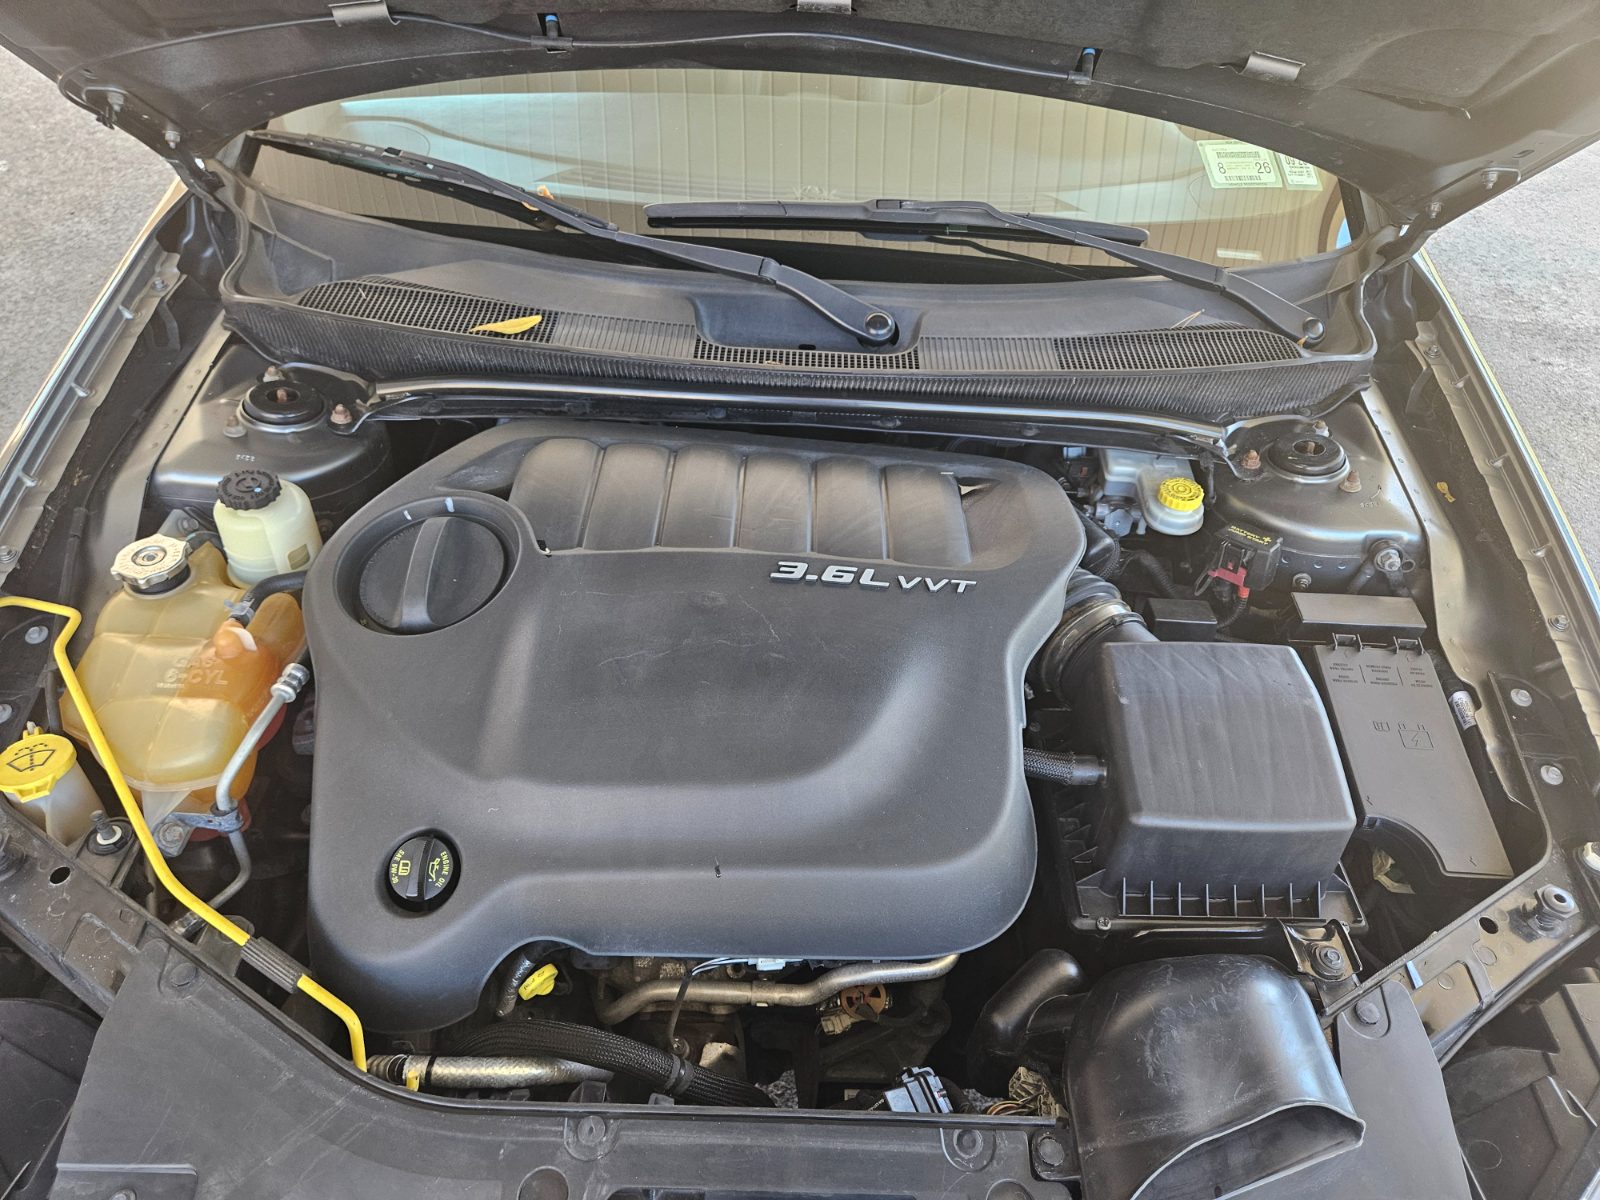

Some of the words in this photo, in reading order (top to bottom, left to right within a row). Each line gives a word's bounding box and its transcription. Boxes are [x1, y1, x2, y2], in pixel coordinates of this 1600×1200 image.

[1217, 162, 1226, 174] 8
[1255, 161, 1271, 174] 26
[769, 561, 890, 588] 3.6L
[897, 575, 977, 593] VVT
[394, 849, 405, 861] SAE
[440, 851, 450, 876] ENGINE
[434, 877, 445, 888] OIL
